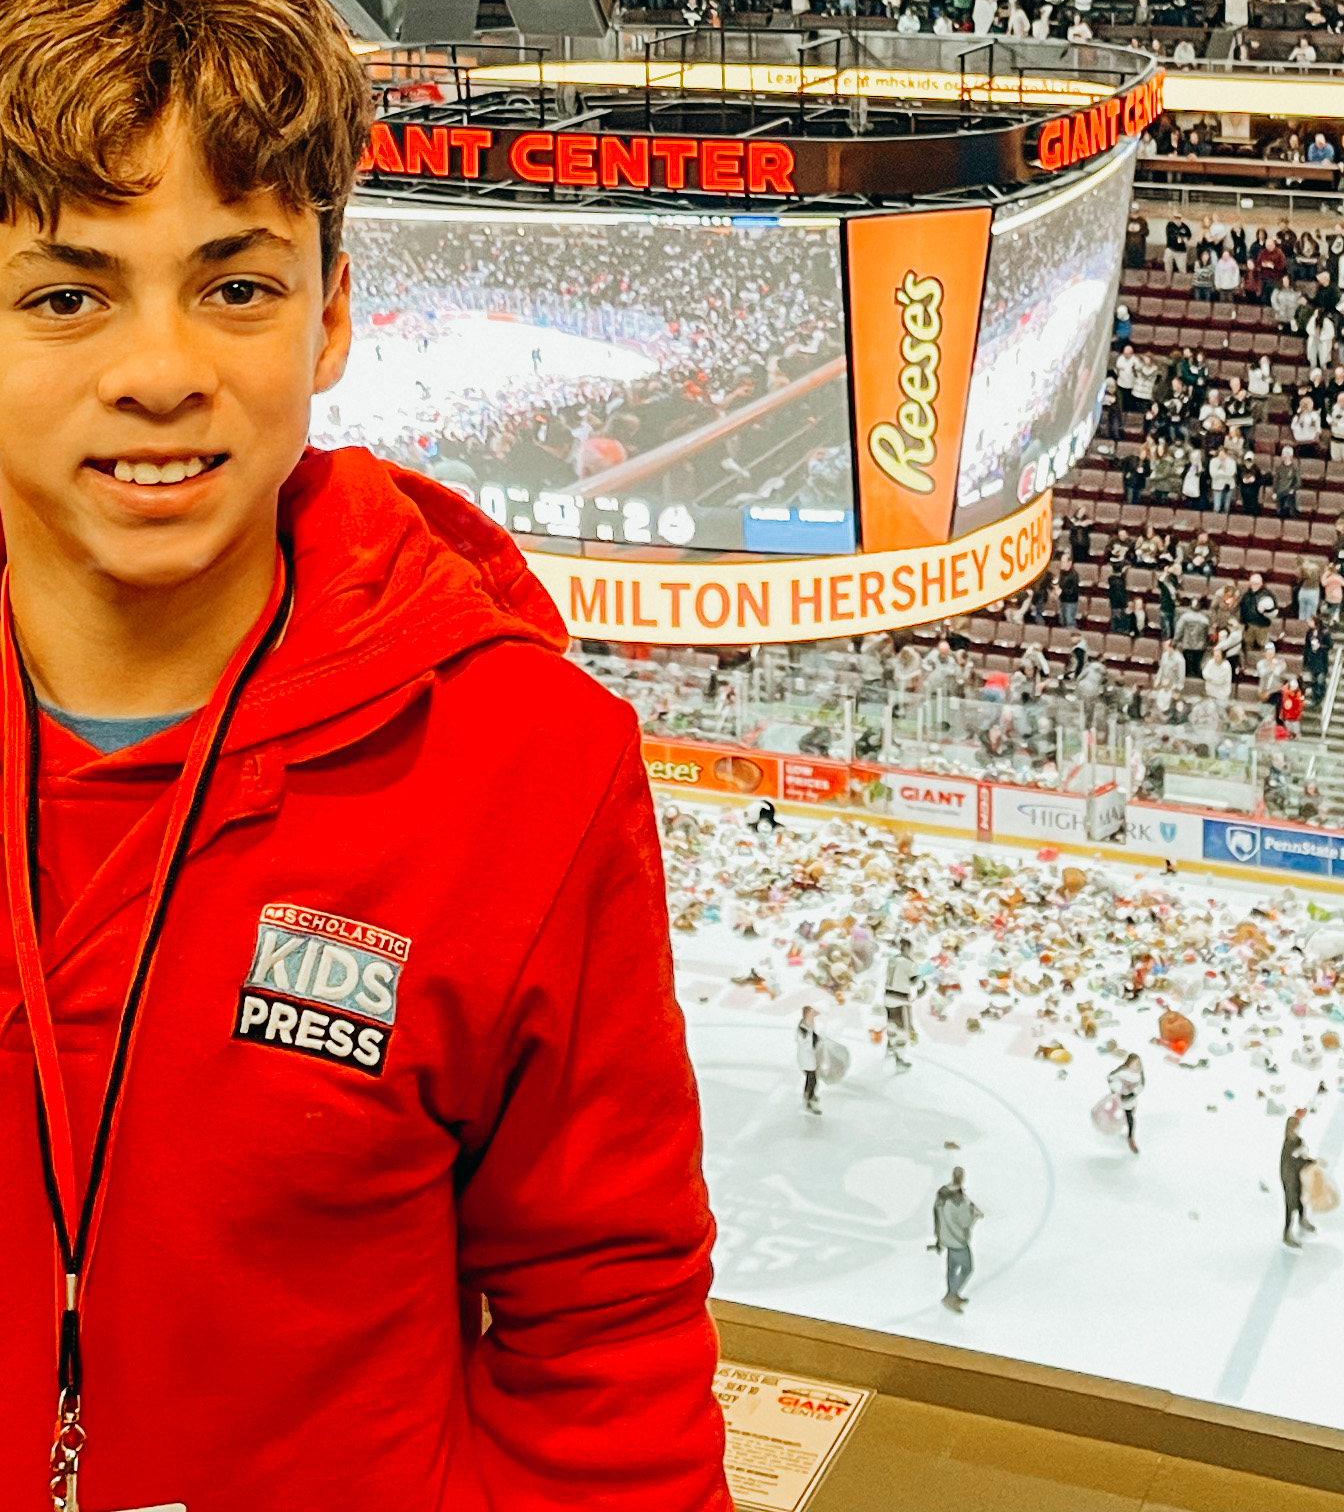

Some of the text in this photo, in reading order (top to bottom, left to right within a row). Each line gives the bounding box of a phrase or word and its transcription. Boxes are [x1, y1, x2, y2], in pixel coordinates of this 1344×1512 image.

[360, 123, 795, 194] ANT CENTER
[1038, 98, 1120, 171] GIANT
[868, 270, 944, 495] Reese's
[570, 575, 769, 629] MILTON
[790, 545, 991, 625] HERSHEY
[644, 759, 702, 782] ese's
[899, 786, 966, 808] GIANT
[284, 909, 405, 955] SCHOLASTIC
[251, 931, 394, 1015] KIDS
[240, 996, 384, 1066] PRESS
[778, 1395, 847, 1416] GIANT
